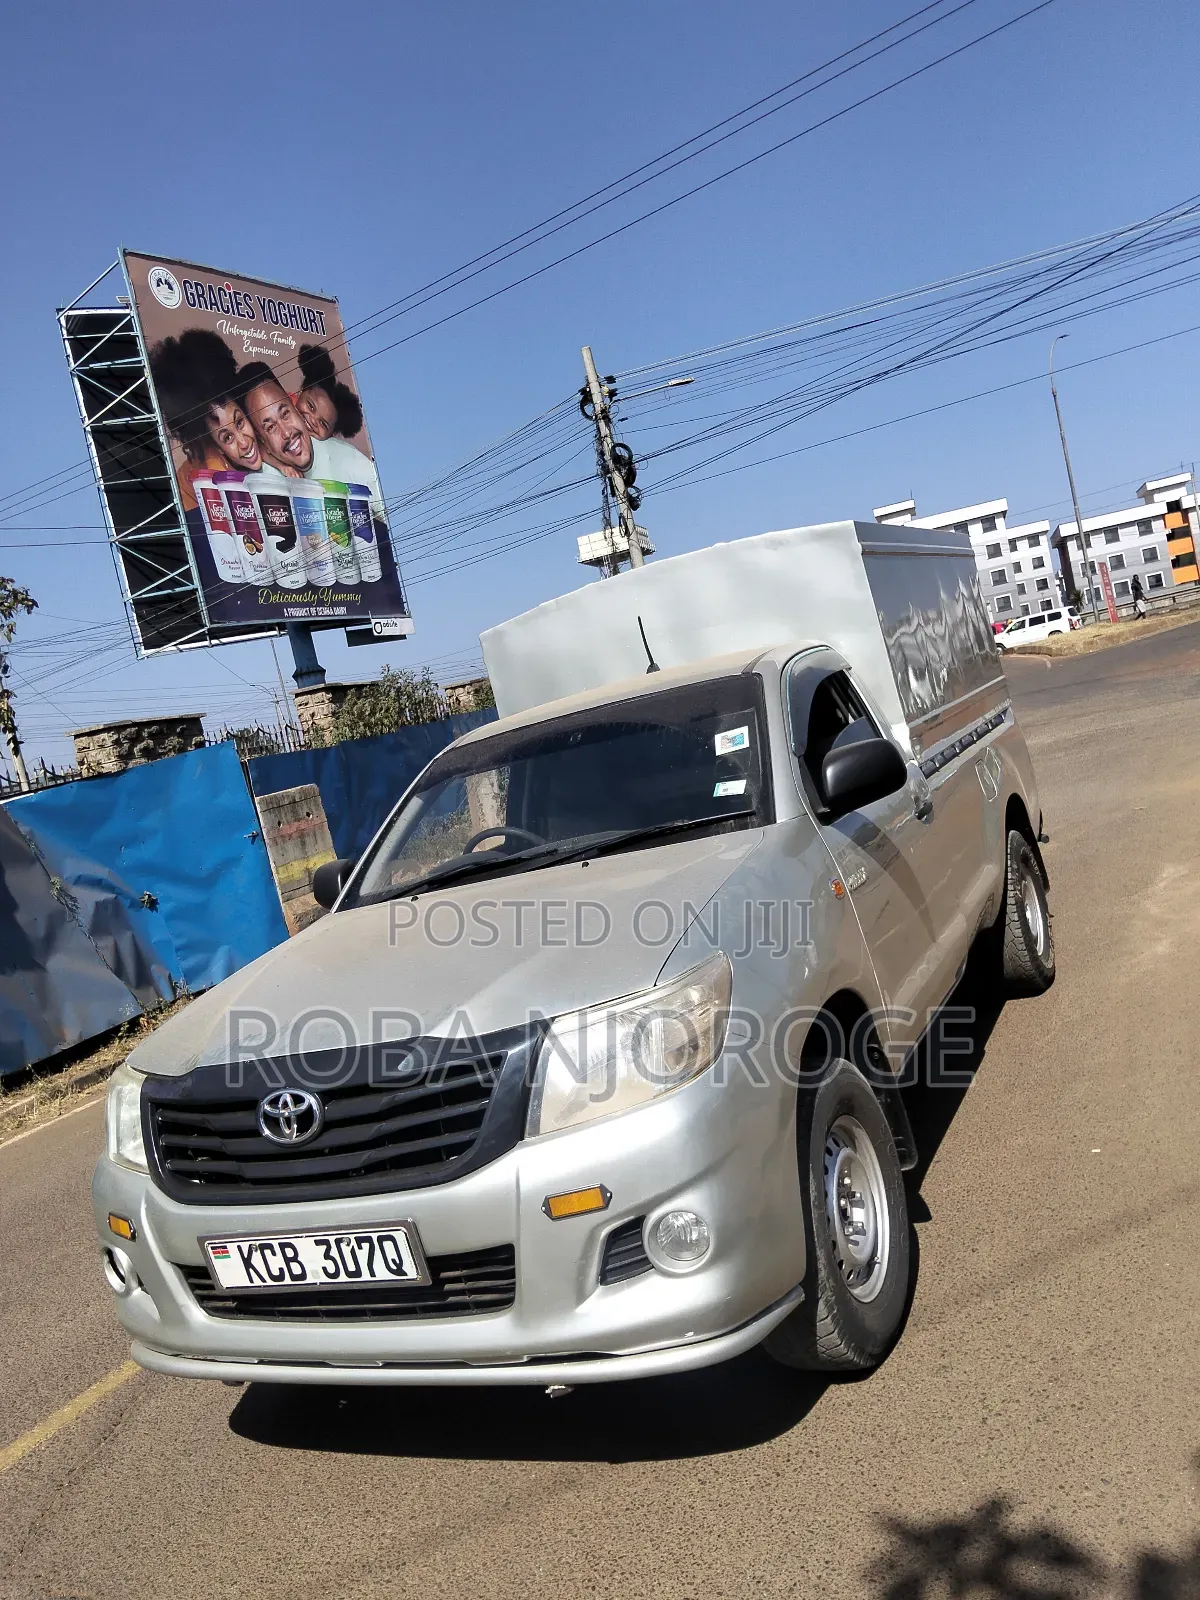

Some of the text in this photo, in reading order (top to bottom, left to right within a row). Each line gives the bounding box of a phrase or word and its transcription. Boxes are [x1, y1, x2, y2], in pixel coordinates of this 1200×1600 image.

[255, 294, 327, 337] YOGHURT
[216, 319, 297, 349] Unforgetable Family
[243, 339, 280, 357] Experience
[267, 513, 287, 525] Yogurt
[268, 508, 289, 517] Gracies
[326, 507, 344, 517] Gracies
[258, 587, 361, 606] Deliciously Yummy
[283, 608, 288, 617] A
[288, 607, 310, 617] PRODUCT
[310, 607, 317, 616] OF
[236, 1241, 308, 1283] KCB
[313, 1234, 409, 1280] 307Q
